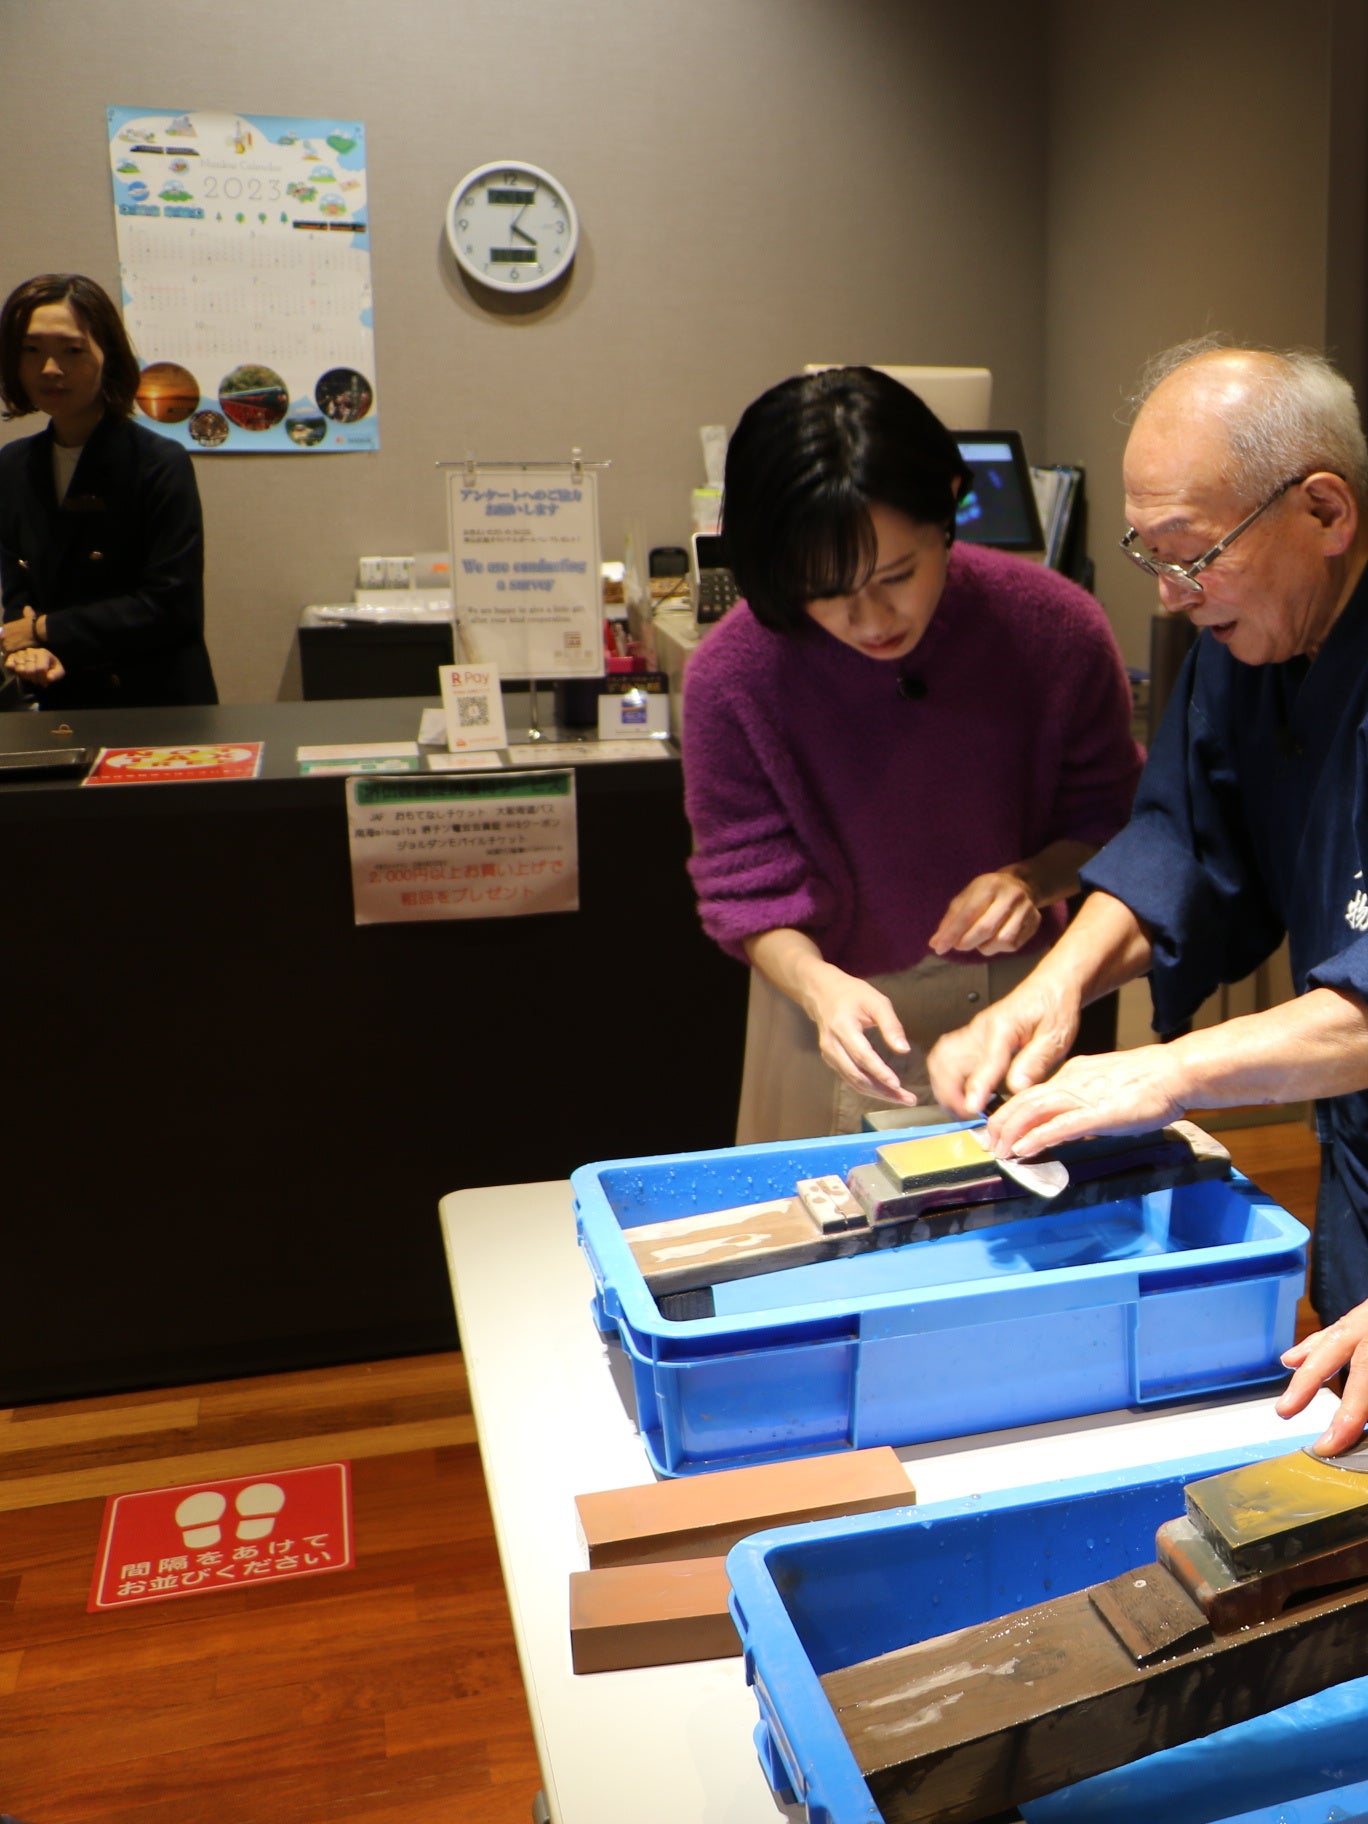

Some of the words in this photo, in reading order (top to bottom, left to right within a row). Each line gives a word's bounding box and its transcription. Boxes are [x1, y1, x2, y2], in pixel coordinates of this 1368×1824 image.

[503, 173, 518, 186] 12
[204, 176, 281, 201] 2023
[460, 219, 469, 231] 9
[556, 221, 565, 235] 3
[510, 267, 519, 281] 6
[462, 558, 484, 573] We
[487, 561, 509, 573] are
[513, 557, 588, 574] conducting
[496, 579, 506, 591] a
[509, 579, 555, 592] survey
[451, 672, 462, 687] R
[464, 671, 489, 684] Pay
[121, 1533, 329, 1579] 間隔をあけて
[116, 1551, 332, 1596] お並びください
